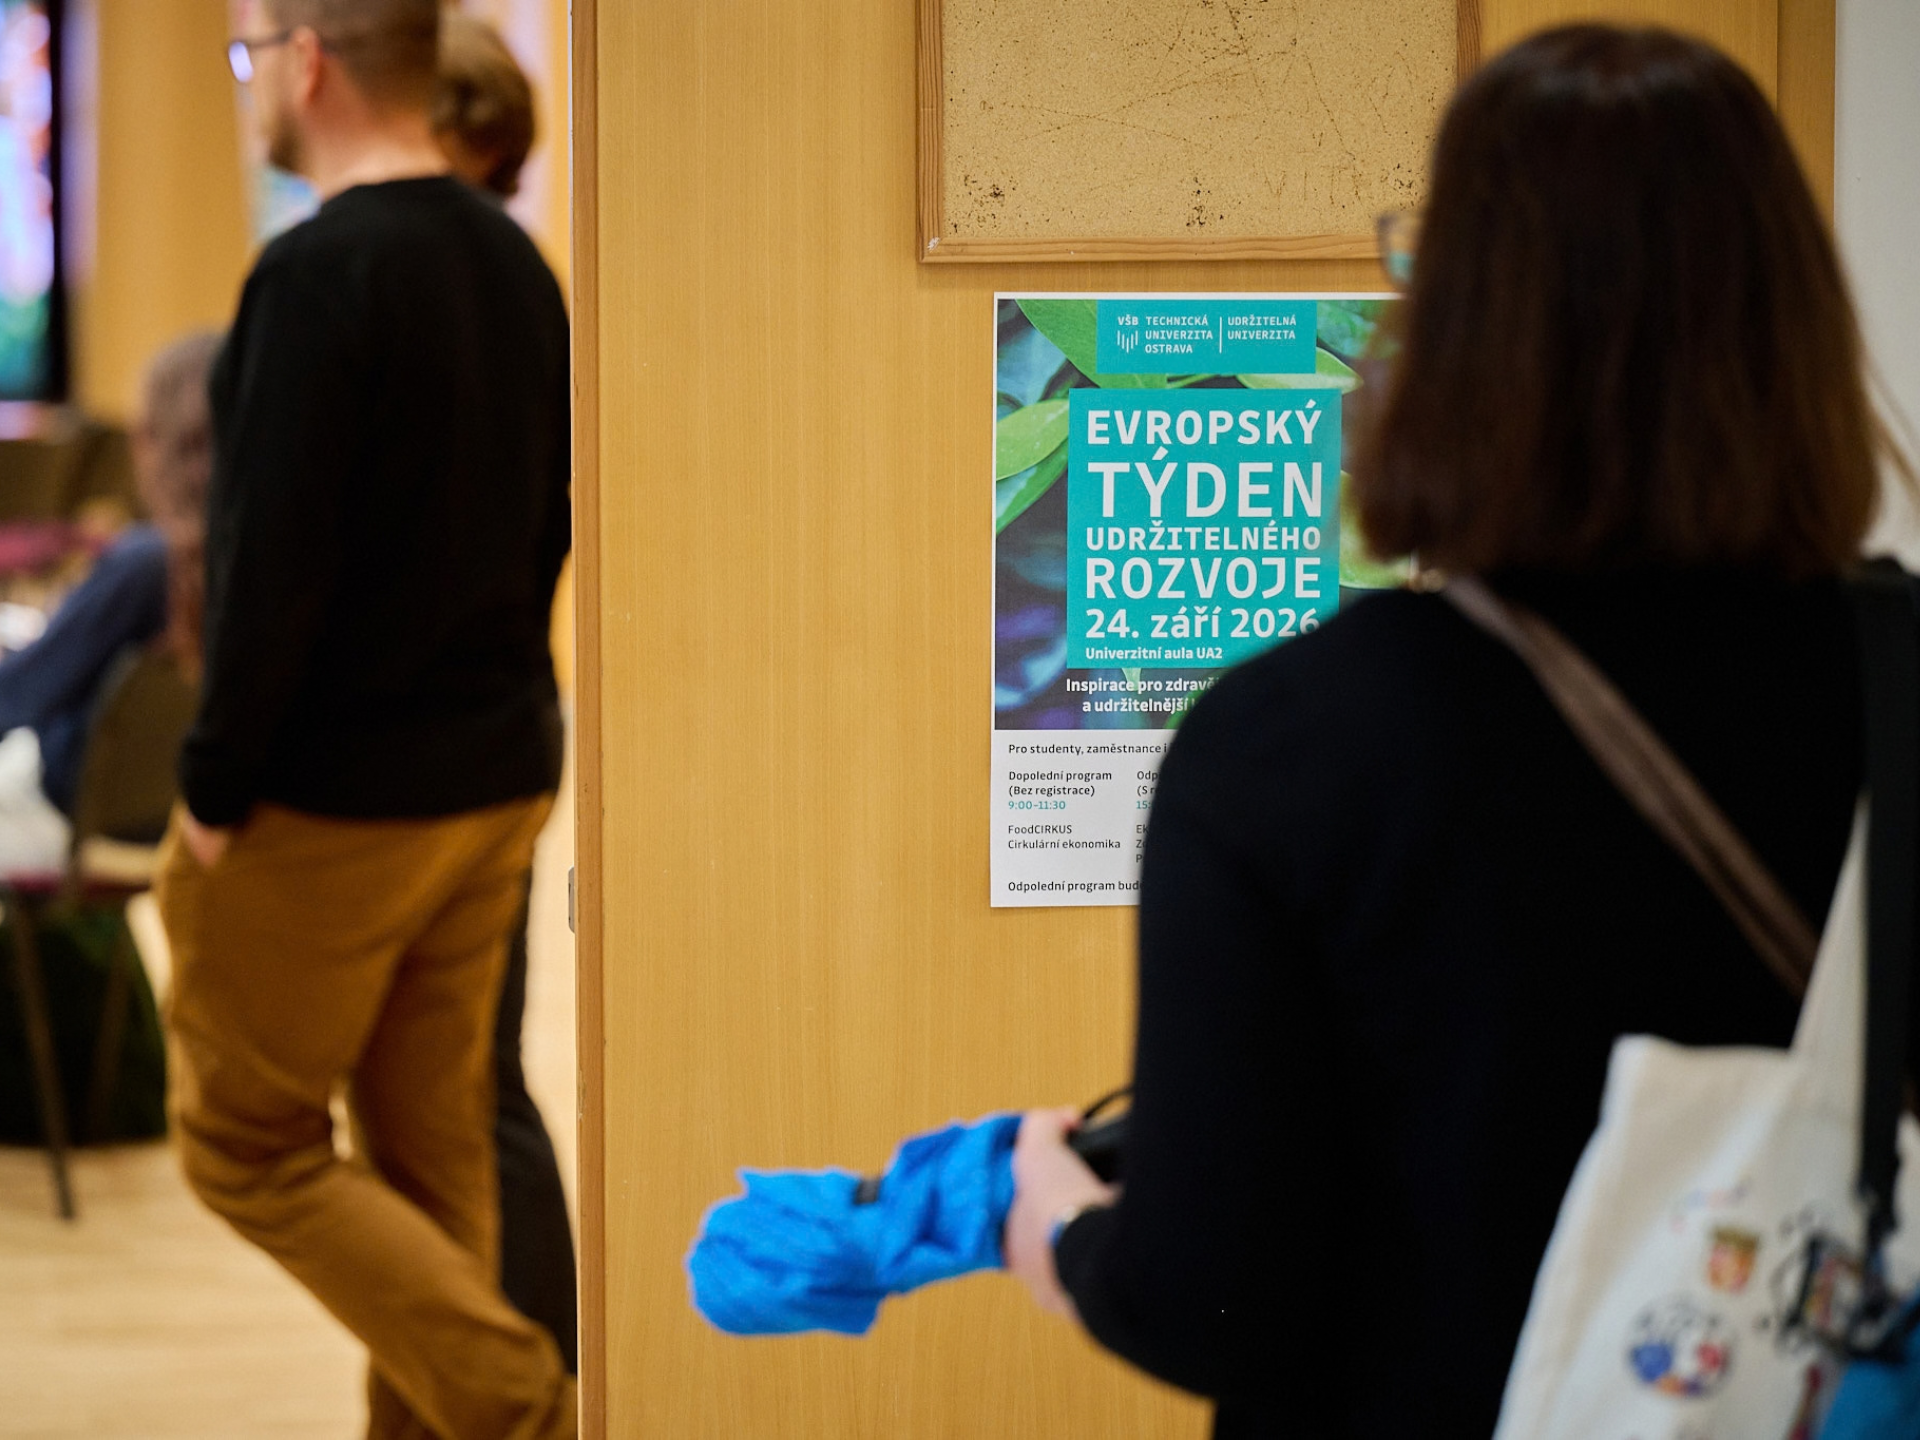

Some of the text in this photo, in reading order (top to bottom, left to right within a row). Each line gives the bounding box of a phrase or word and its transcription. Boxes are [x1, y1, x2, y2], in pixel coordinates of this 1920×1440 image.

[1117, 314, 1139, 326] VŠB
[1145, 314, 1209, 326] TECHNICKÁ
[1227, 314, 1297, 326] UDRŽITELNÁ
[1145, 330, 1213, 340] UNIVERZITA
[1227, 330, 1296, 340] UNIVERZITA
[1145, 344, 1193, 354] OSTRAVA
[1087, 398, 1323, 446] EVROPSKÝ
[1087, 446, 1323, 518] TÝDEN
[1086, 520, 1321, 552] UDRŽITELNÉHO
[1085, 557, 1321, 599] ROZVOJE
[1085, 606, 1320, 639] 24. září 2026
[1085, 647, 1223, 660] Univerzitní aula UA2
[1066, 677, 1219, 695] Inspirace pro zdravě
[1082, 702, 1091, 712] a
[1094, 697, 1189, 715] udržitelnější
[1008, 744, 1027, 754] Pro
[1030, 744, 1084, 756] studenty,
[1086, 743, 1162, 754] zaměstnance
[1008, 770, 1112, 783] Dopolední program
[1008, 785, 1095, 797] (Bez registrace)
[1007, 824, 1073, 835] FoodCIRKUS
[1007, 839, 1121, 849] Cirkulární ekonomika
[1008, 881, 1065, 893] Odpolední
[1067, 883, 1115, 893] program
